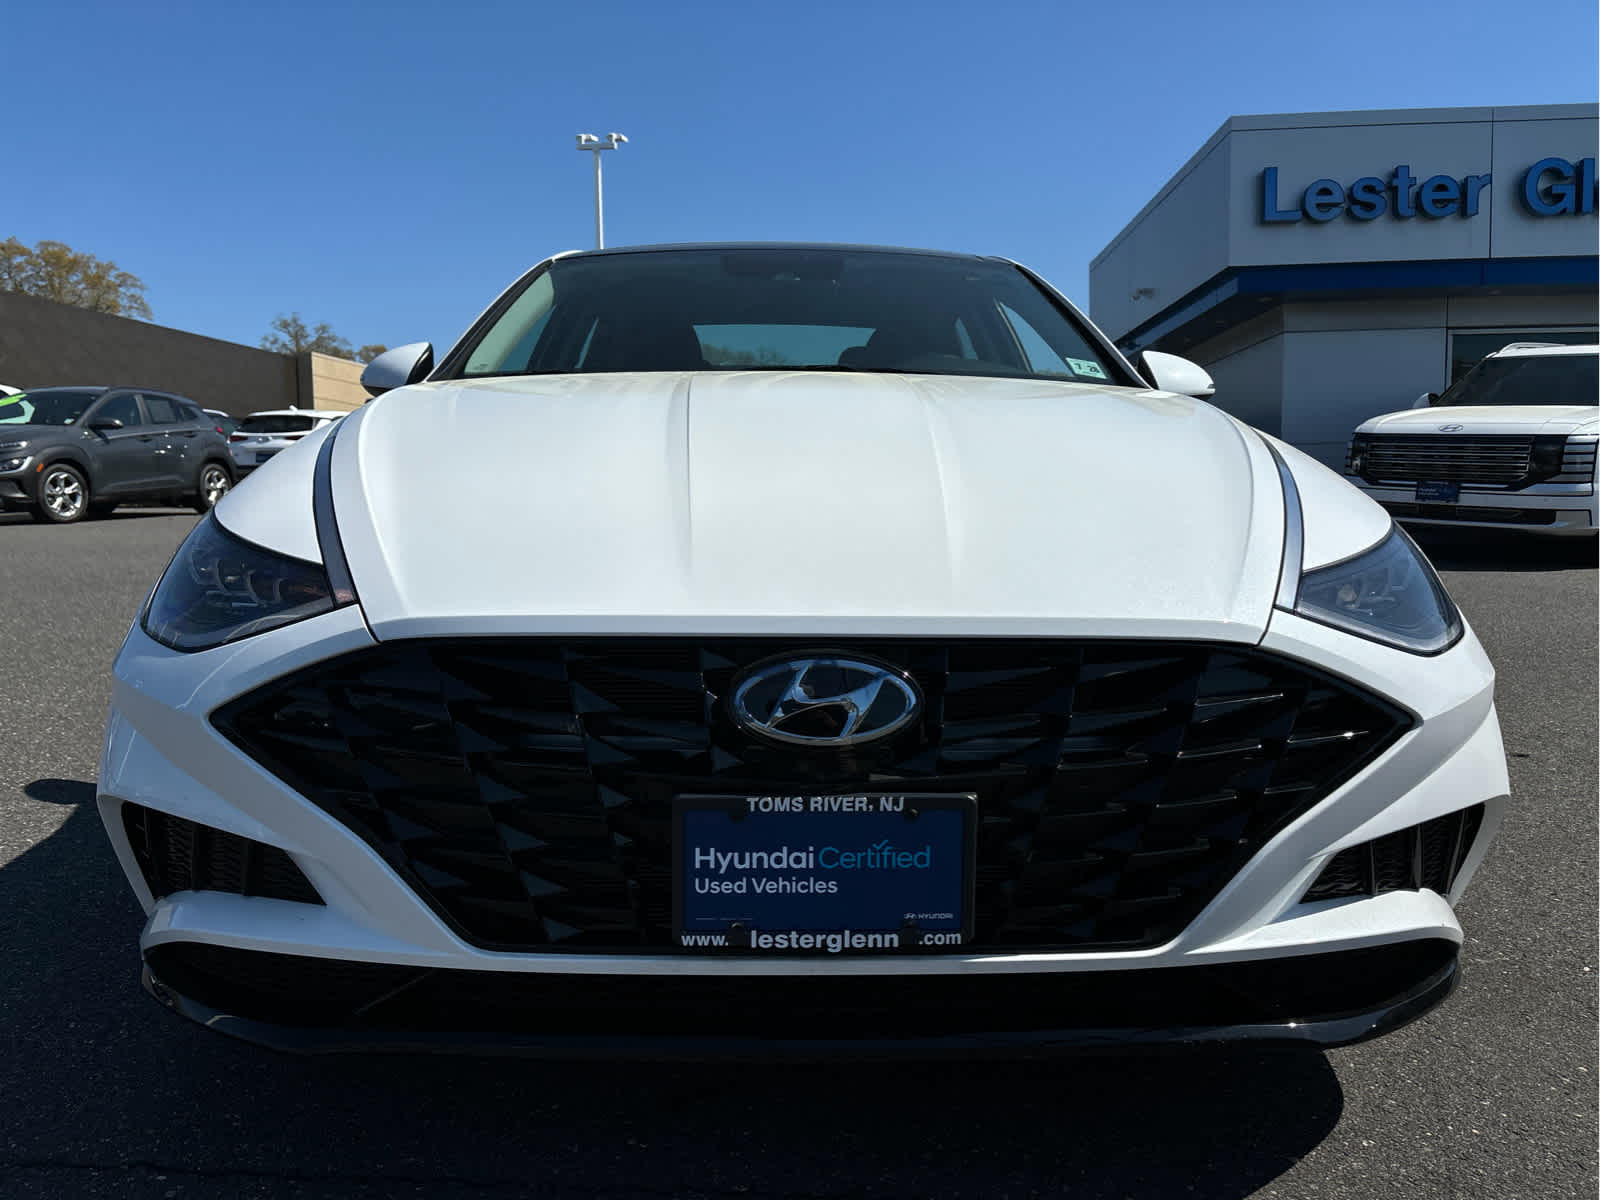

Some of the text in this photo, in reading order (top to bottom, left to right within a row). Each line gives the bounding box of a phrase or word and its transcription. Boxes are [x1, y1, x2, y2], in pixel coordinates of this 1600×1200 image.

[1261, 157, 1599, 222] Lester Gl
[747, 797, 905, 813] TOMS RIVER, NJ
[695, 840, 931, 874] Hyundai Certified
[695, 877, 838, 894] Used Vehicles
[681, 930, 962, 952] www. lesterglenn .com
